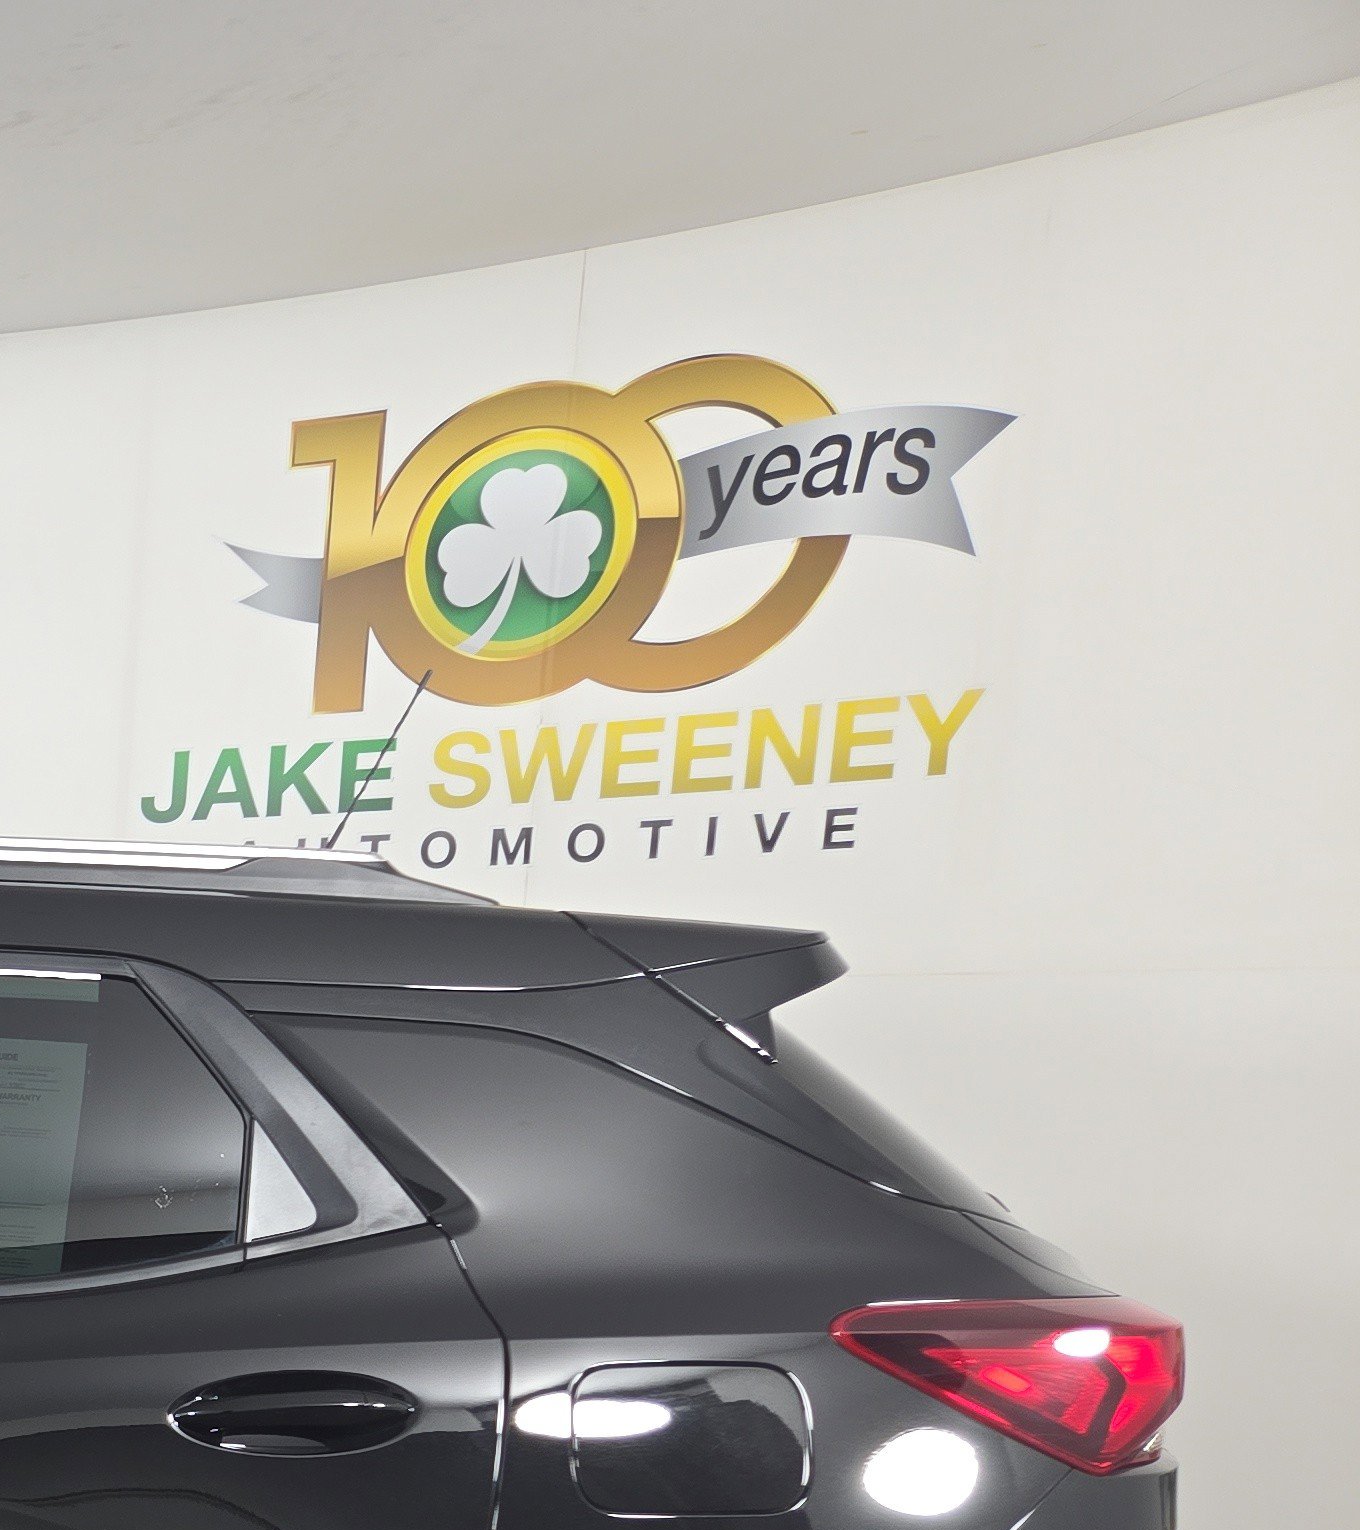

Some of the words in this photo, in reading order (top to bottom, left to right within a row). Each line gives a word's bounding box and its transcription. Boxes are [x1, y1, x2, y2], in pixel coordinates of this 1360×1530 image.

[291, 353, 853, 714] 100
[698, 425, 936, 541] years
[140, 737, 398, 825] JAKE
[427, 688, 987, 809] SWEENEY
[244, 806, 858, 870] TOMOTIVE
